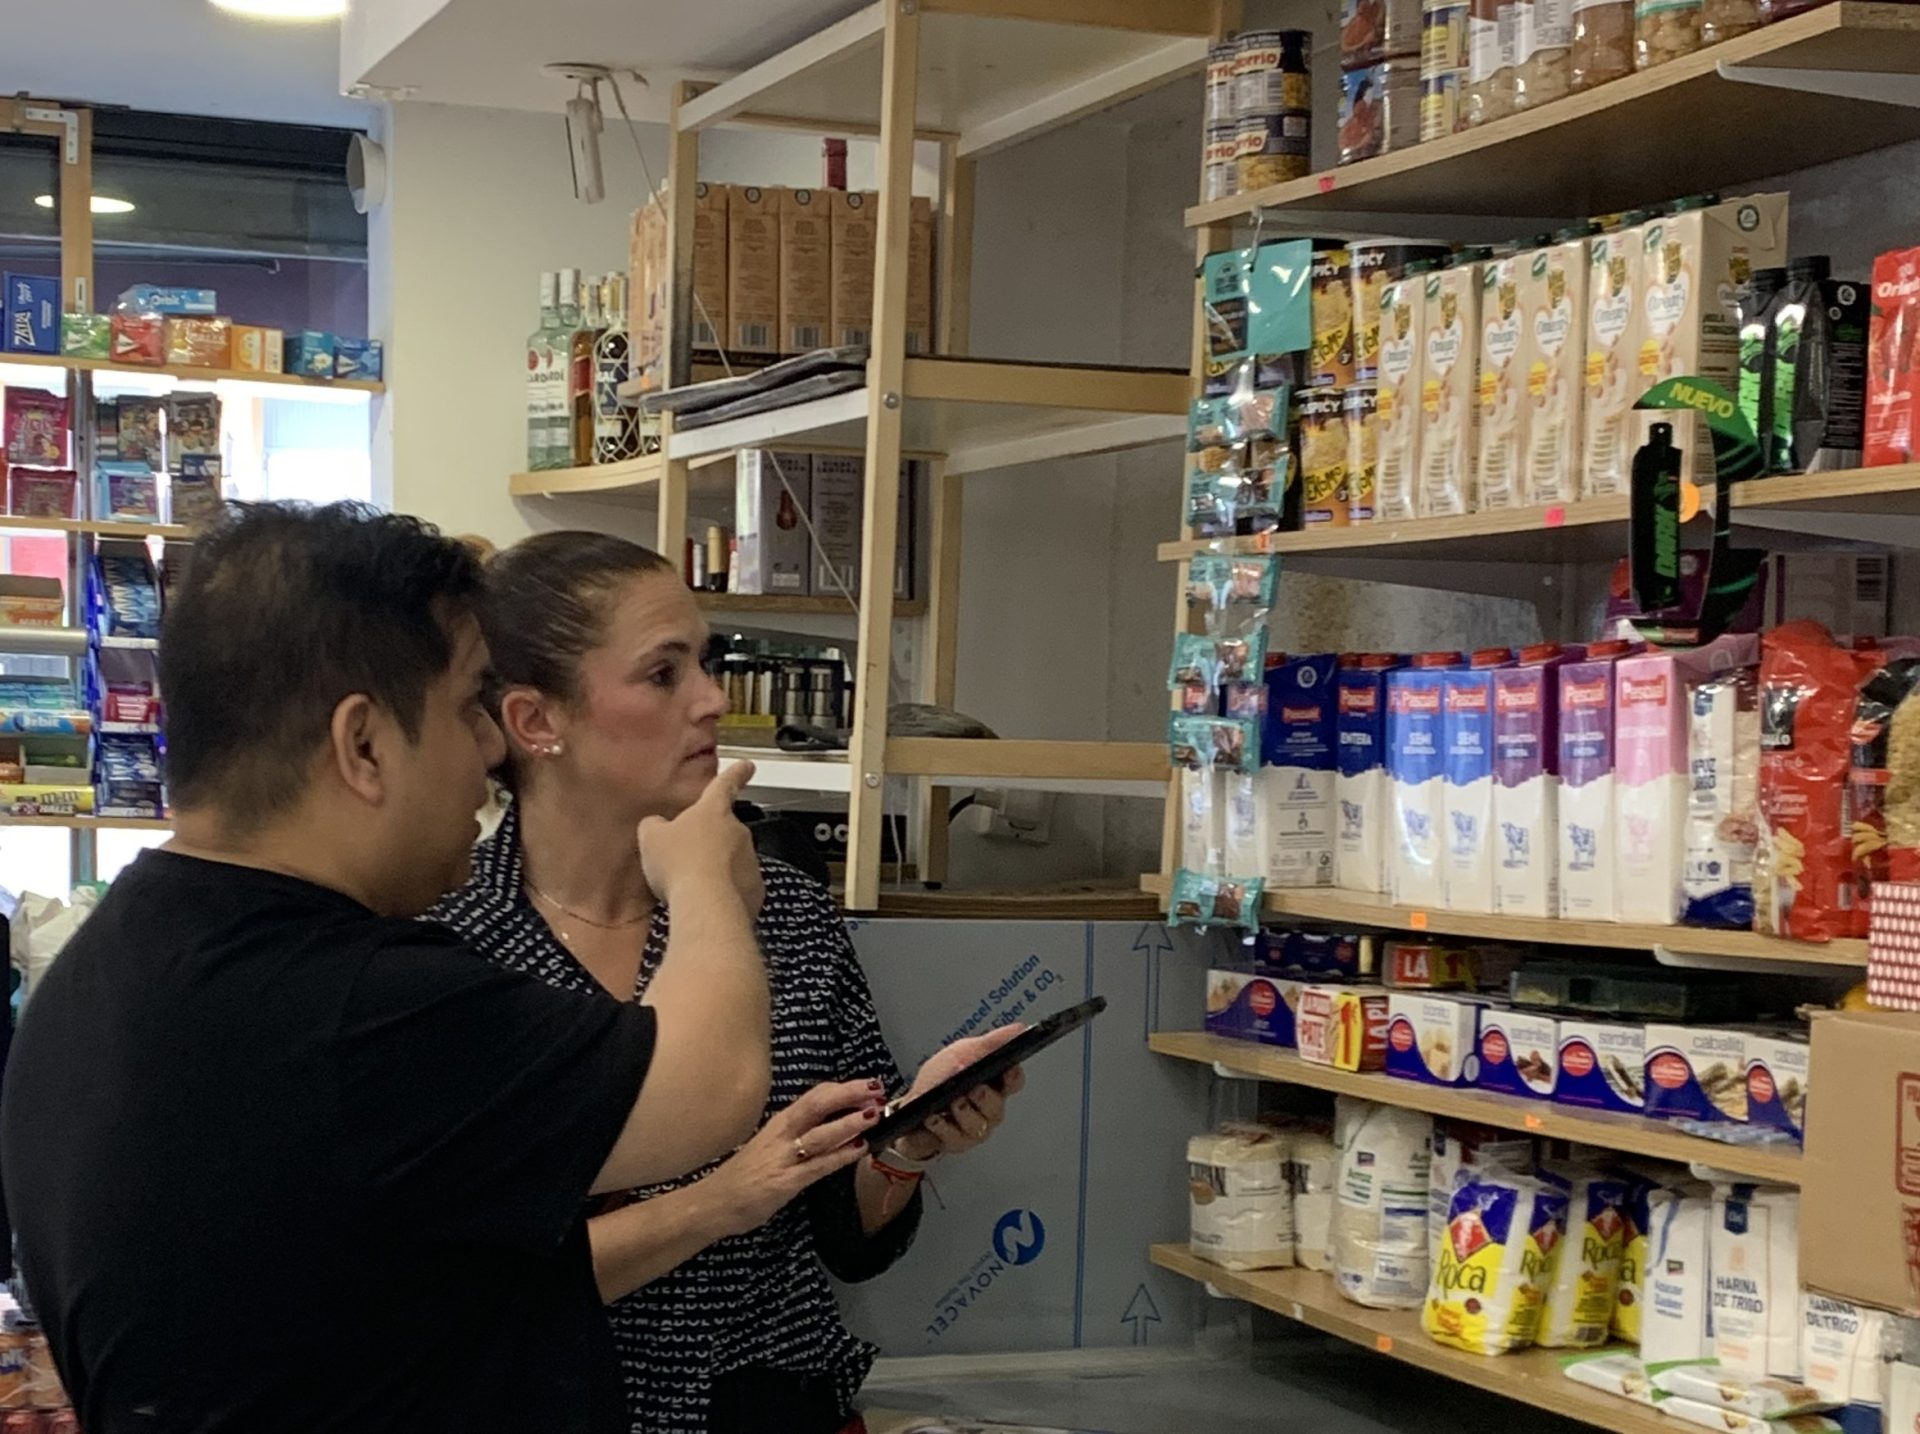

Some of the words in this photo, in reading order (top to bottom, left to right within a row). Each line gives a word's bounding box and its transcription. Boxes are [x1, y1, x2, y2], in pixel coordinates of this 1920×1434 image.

[1669, 382, 1734, 418] NUEVO
[1404, 954, 1429, 978] LA
[941, 1000, 991, 1047] Novacel
[989, 953, 1041, 1005] Solution
[991, 1001, 1025, 1029] Fiber
[1024, 989, 1037, 1003] &
[926, 1259, 1004, 1336] NOVACEL
[1716, 1275, 1758, 1295] HARINA
[1714, 1293, 1728, 1308] DE
[1806, 1312, 1822, 1328] DE
[1821, 1315, 1859, 1336] TRIGO
